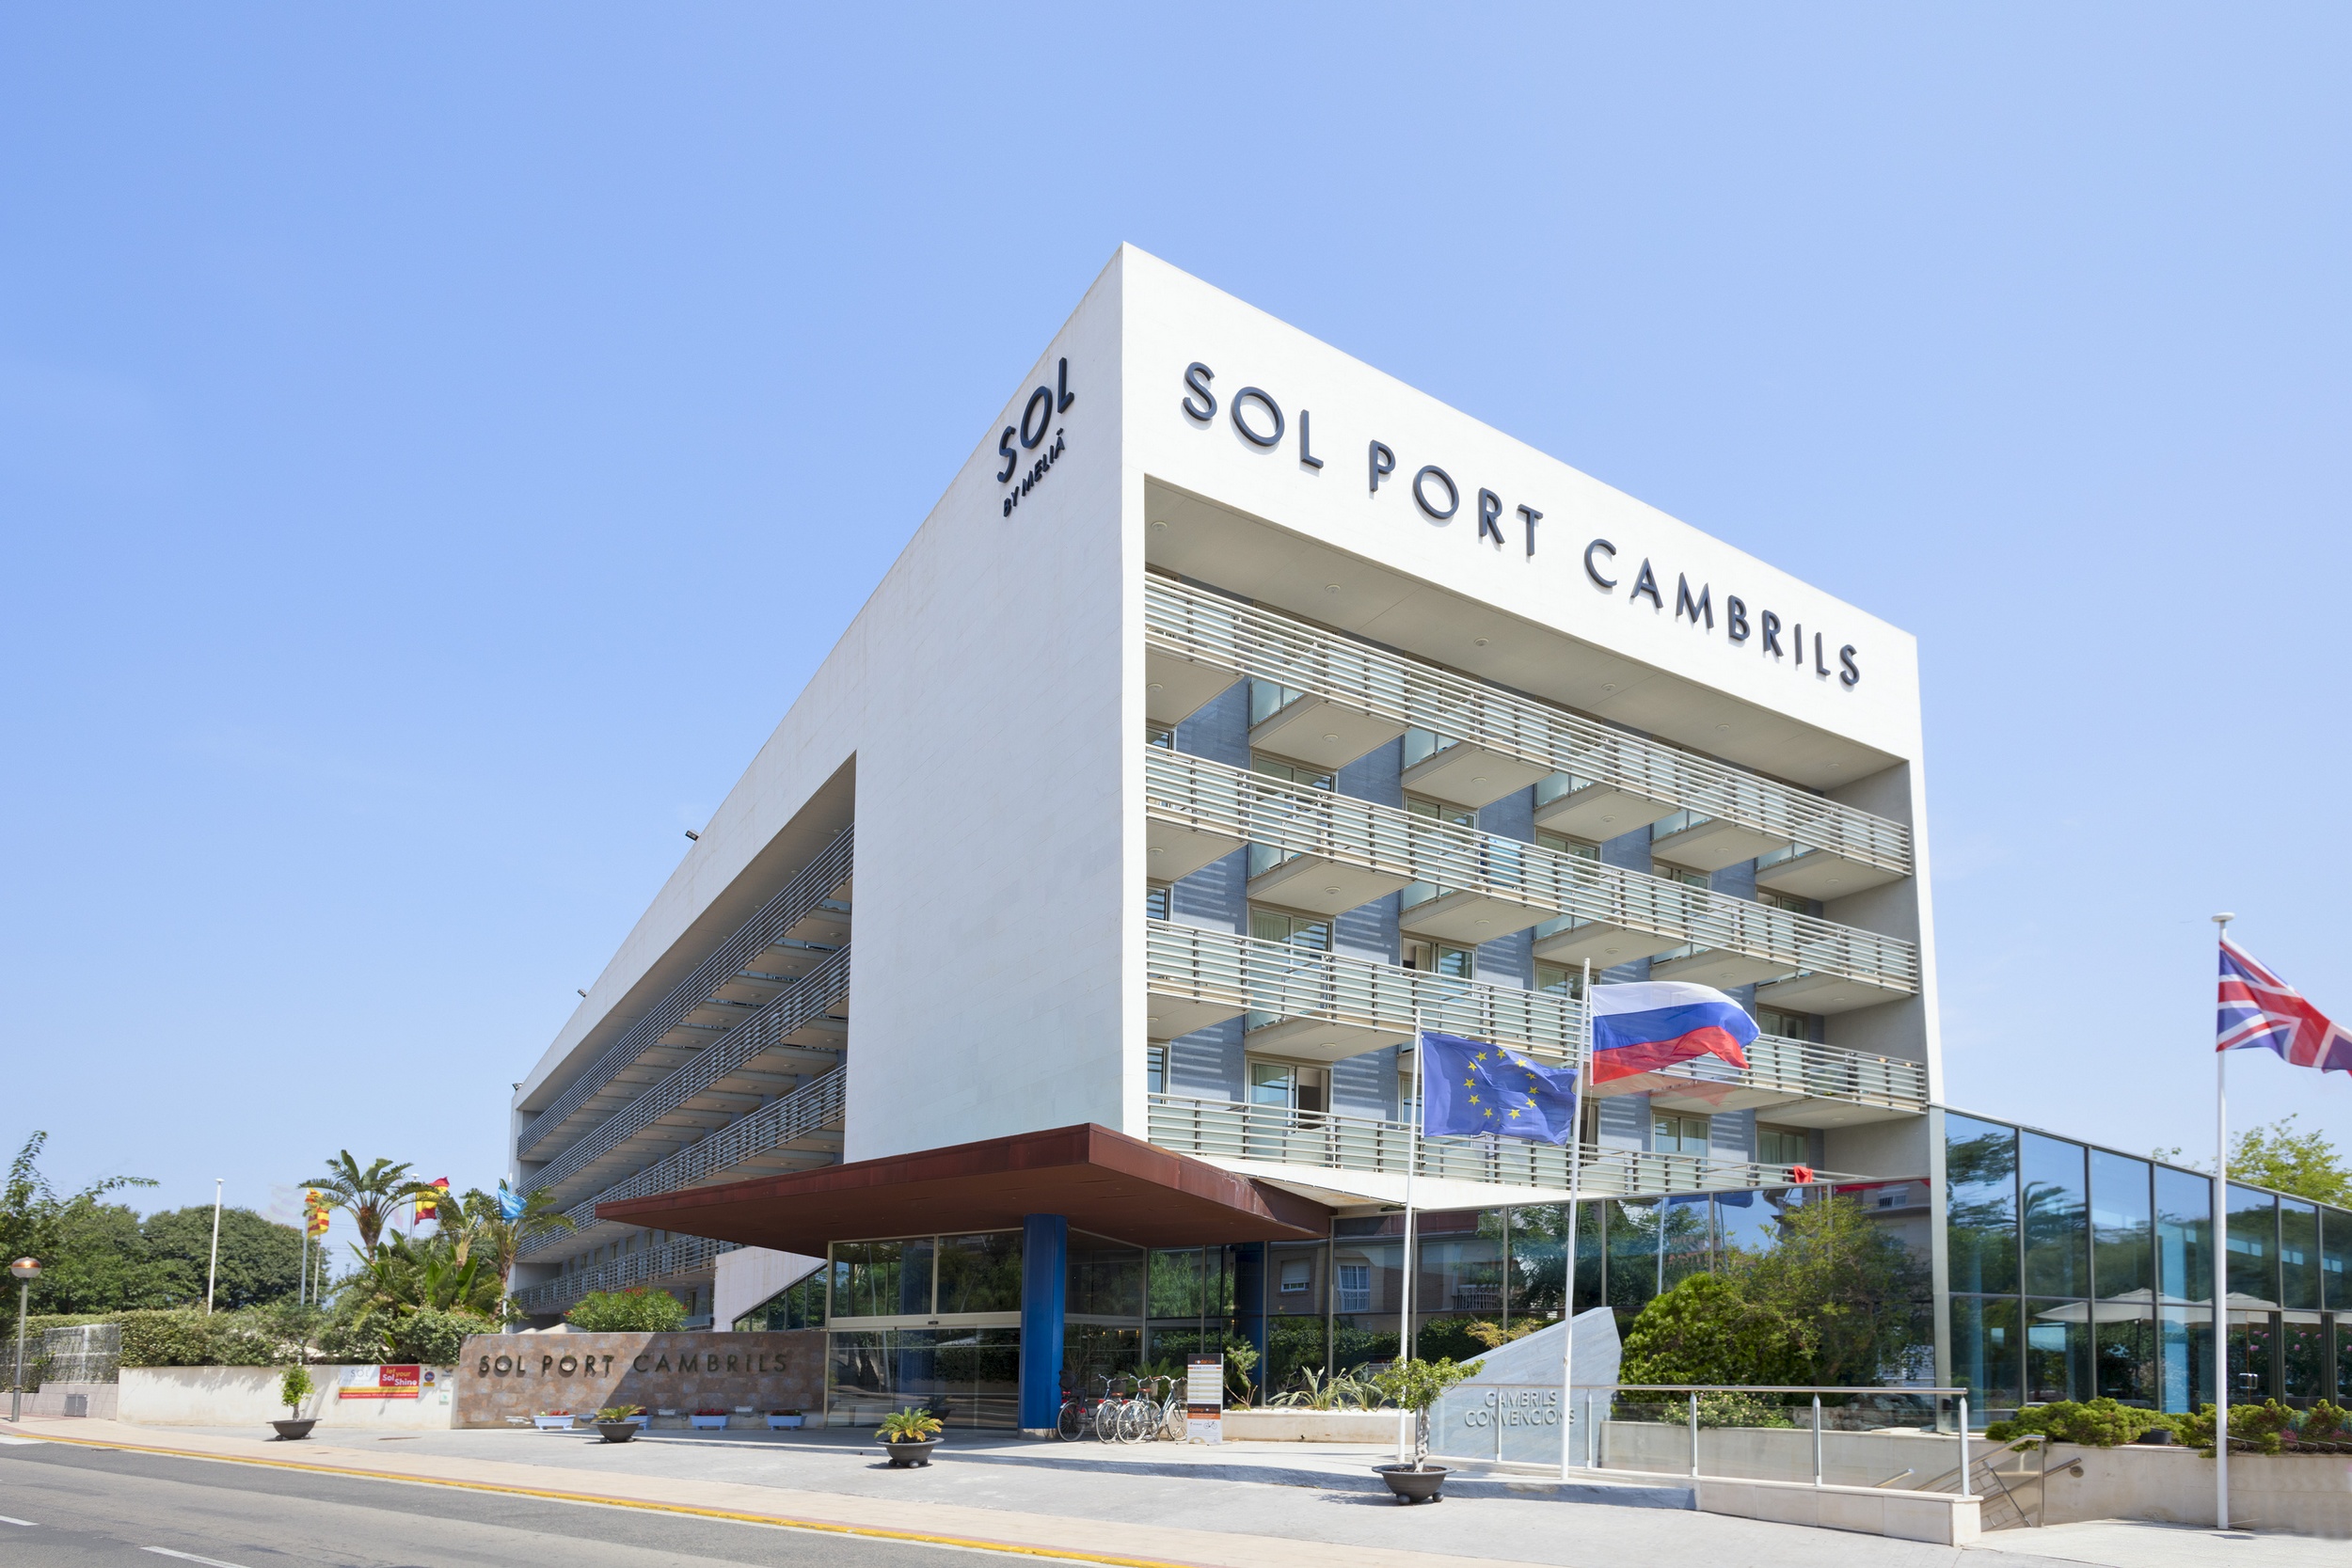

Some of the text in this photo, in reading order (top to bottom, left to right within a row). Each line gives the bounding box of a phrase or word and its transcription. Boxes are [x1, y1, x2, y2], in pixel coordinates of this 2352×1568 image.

[997, 356, 1074, 483] SOL
[1003, 485, 1019, 517] BY
[1182, 362, 1861, 687] SOL PORT CAMBRILS
[479, 1354, 787, 1374] SOL PORT CAMBRILS
[1485, 1391, 1557, 1408] CAMBRILS
